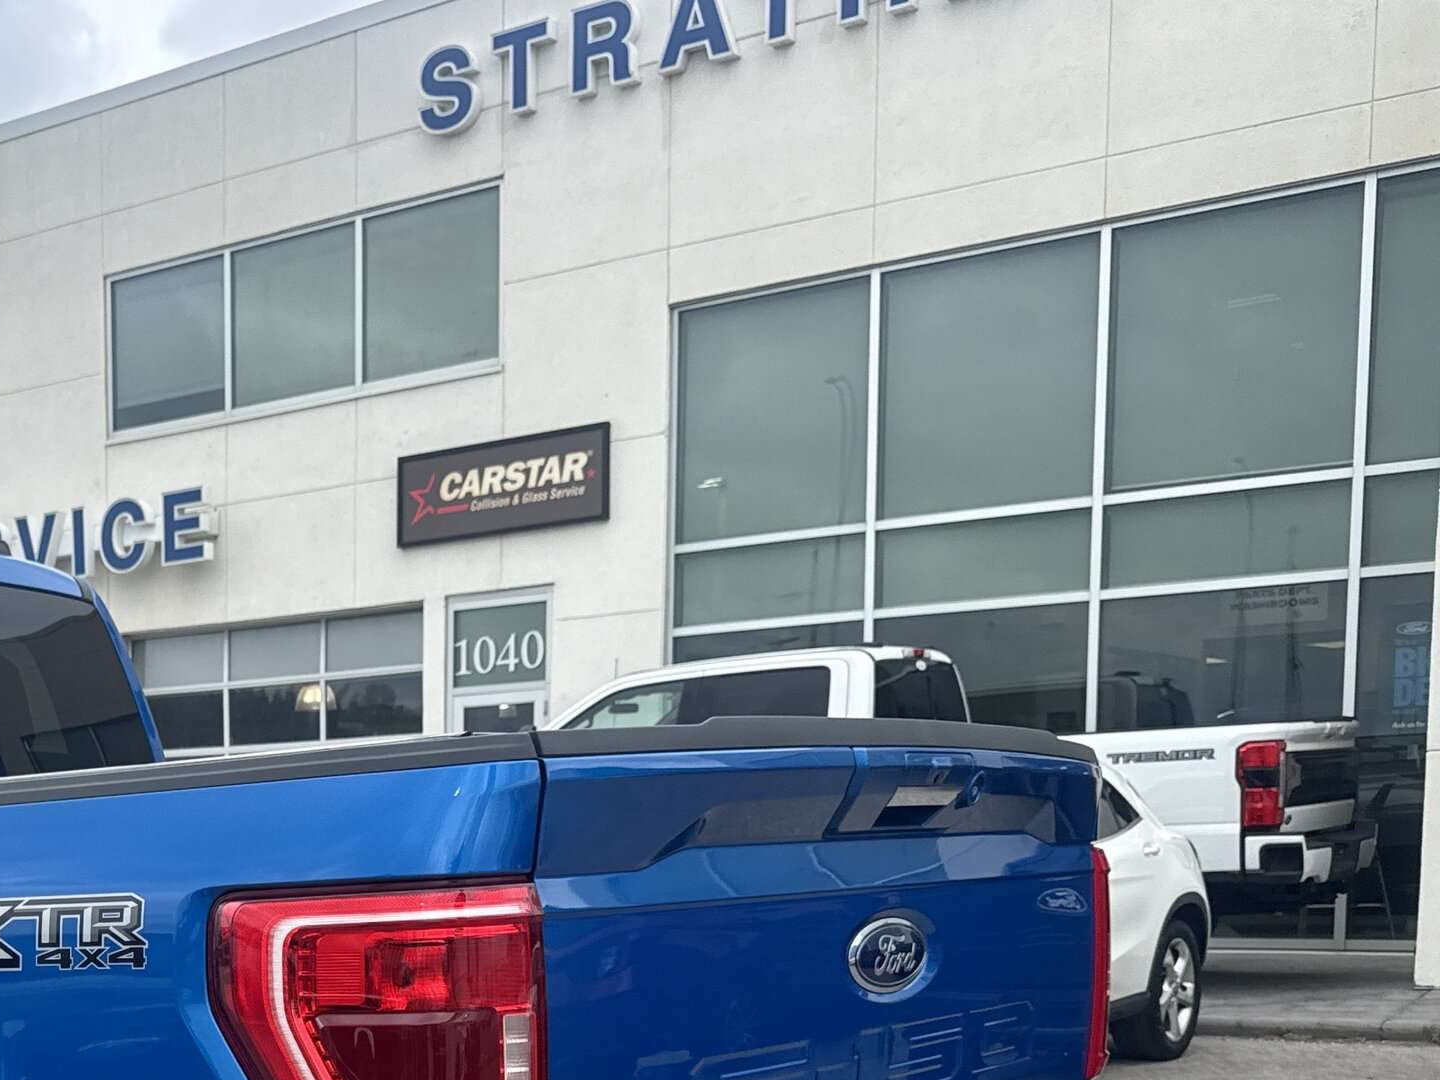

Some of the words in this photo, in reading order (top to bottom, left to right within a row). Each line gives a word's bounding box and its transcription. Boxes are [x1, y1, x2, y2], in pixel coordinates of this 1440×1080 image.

[419, 0, 920, 136] STRA
[439, 451, 589, 502] CARSTAR
[454, 629, 545, 677] 1040
[1107, 748, 1216, 765] TREMOR
[873, 933, 917, 977] Ford
